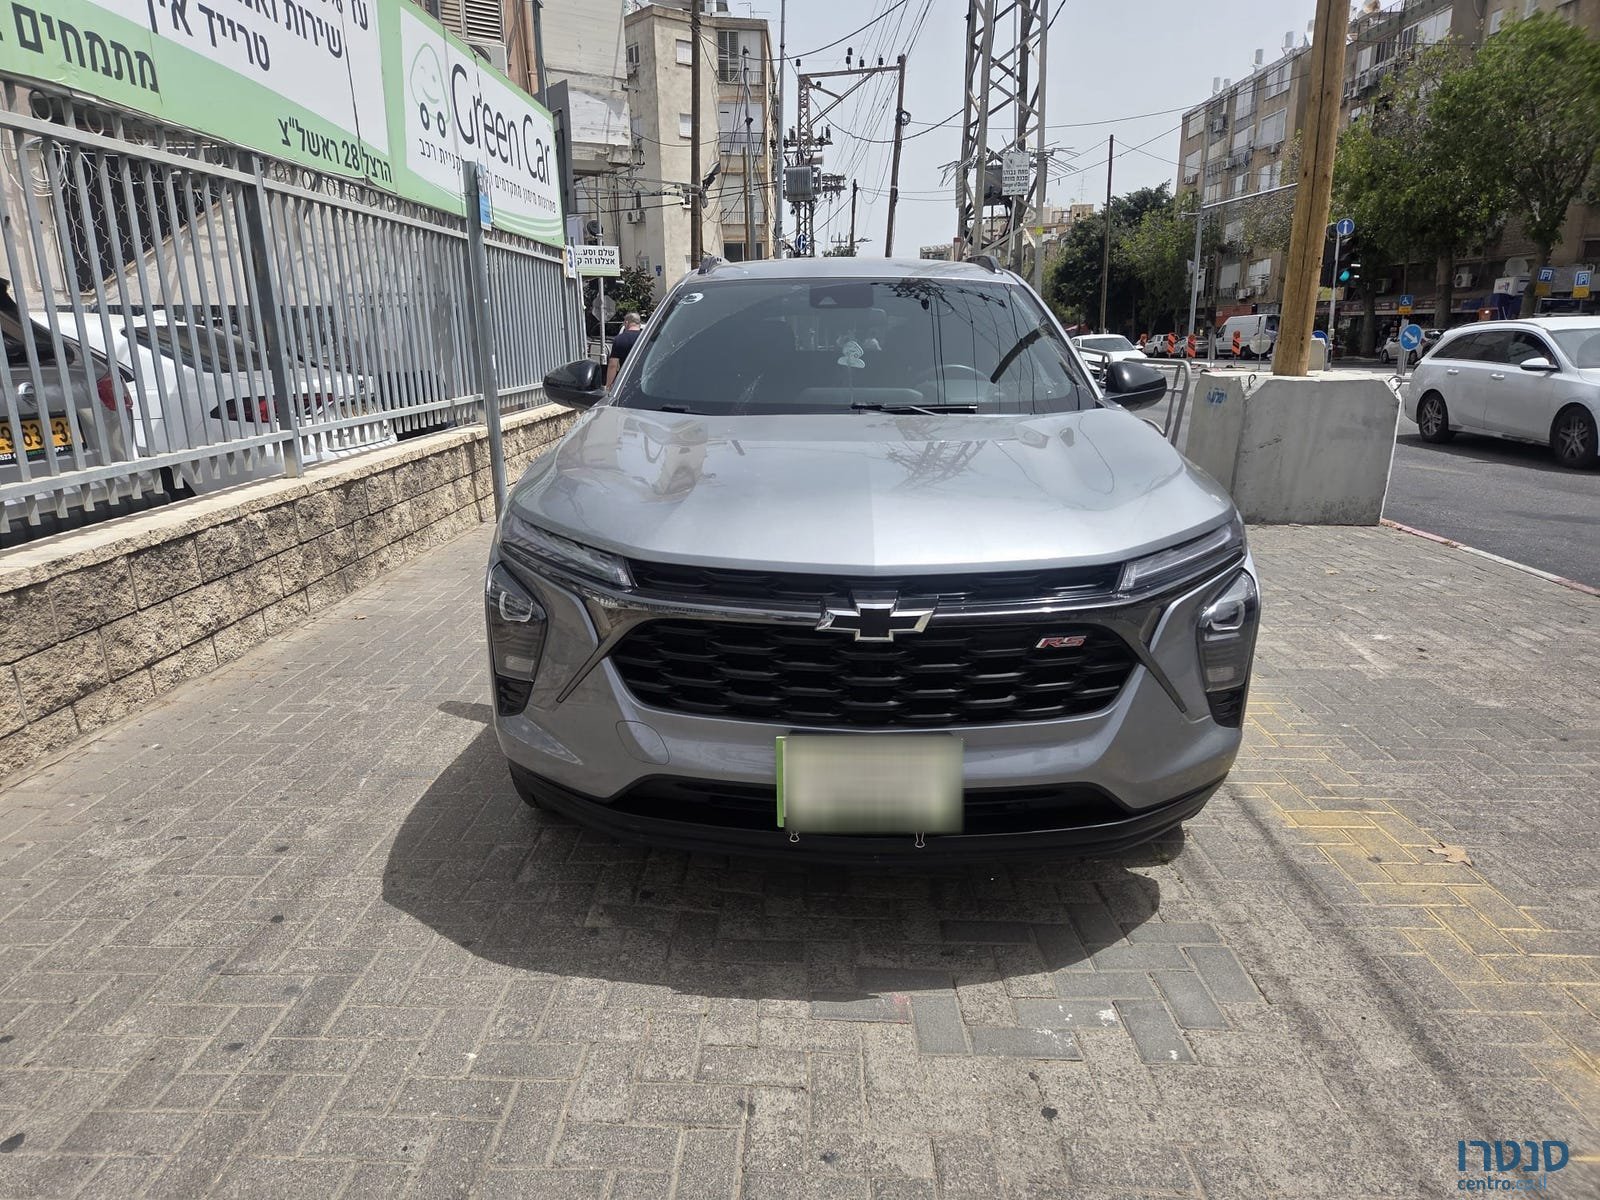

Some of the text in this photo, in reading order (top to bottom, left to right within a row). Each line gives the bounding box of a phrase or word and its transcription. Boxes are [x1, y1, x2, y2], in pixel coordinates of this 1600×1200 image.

[197, 2, 270, 72] טרייד
[284, 0, 343, 59] שירות
[11, 2, 160, 94] מתמחים
[451, 63, 551, 186] Green Car
[342, 140, 361, 171] 28
[361, 146, 393, 184] הרצל
[418, 138, 437, 161] רכב
[584, 257, 593, 265] זה
[594, 257, 616, 265] אצלנו
[598, 248, 615, 257] שלם
[1035, 635, 1087, 649] RS
